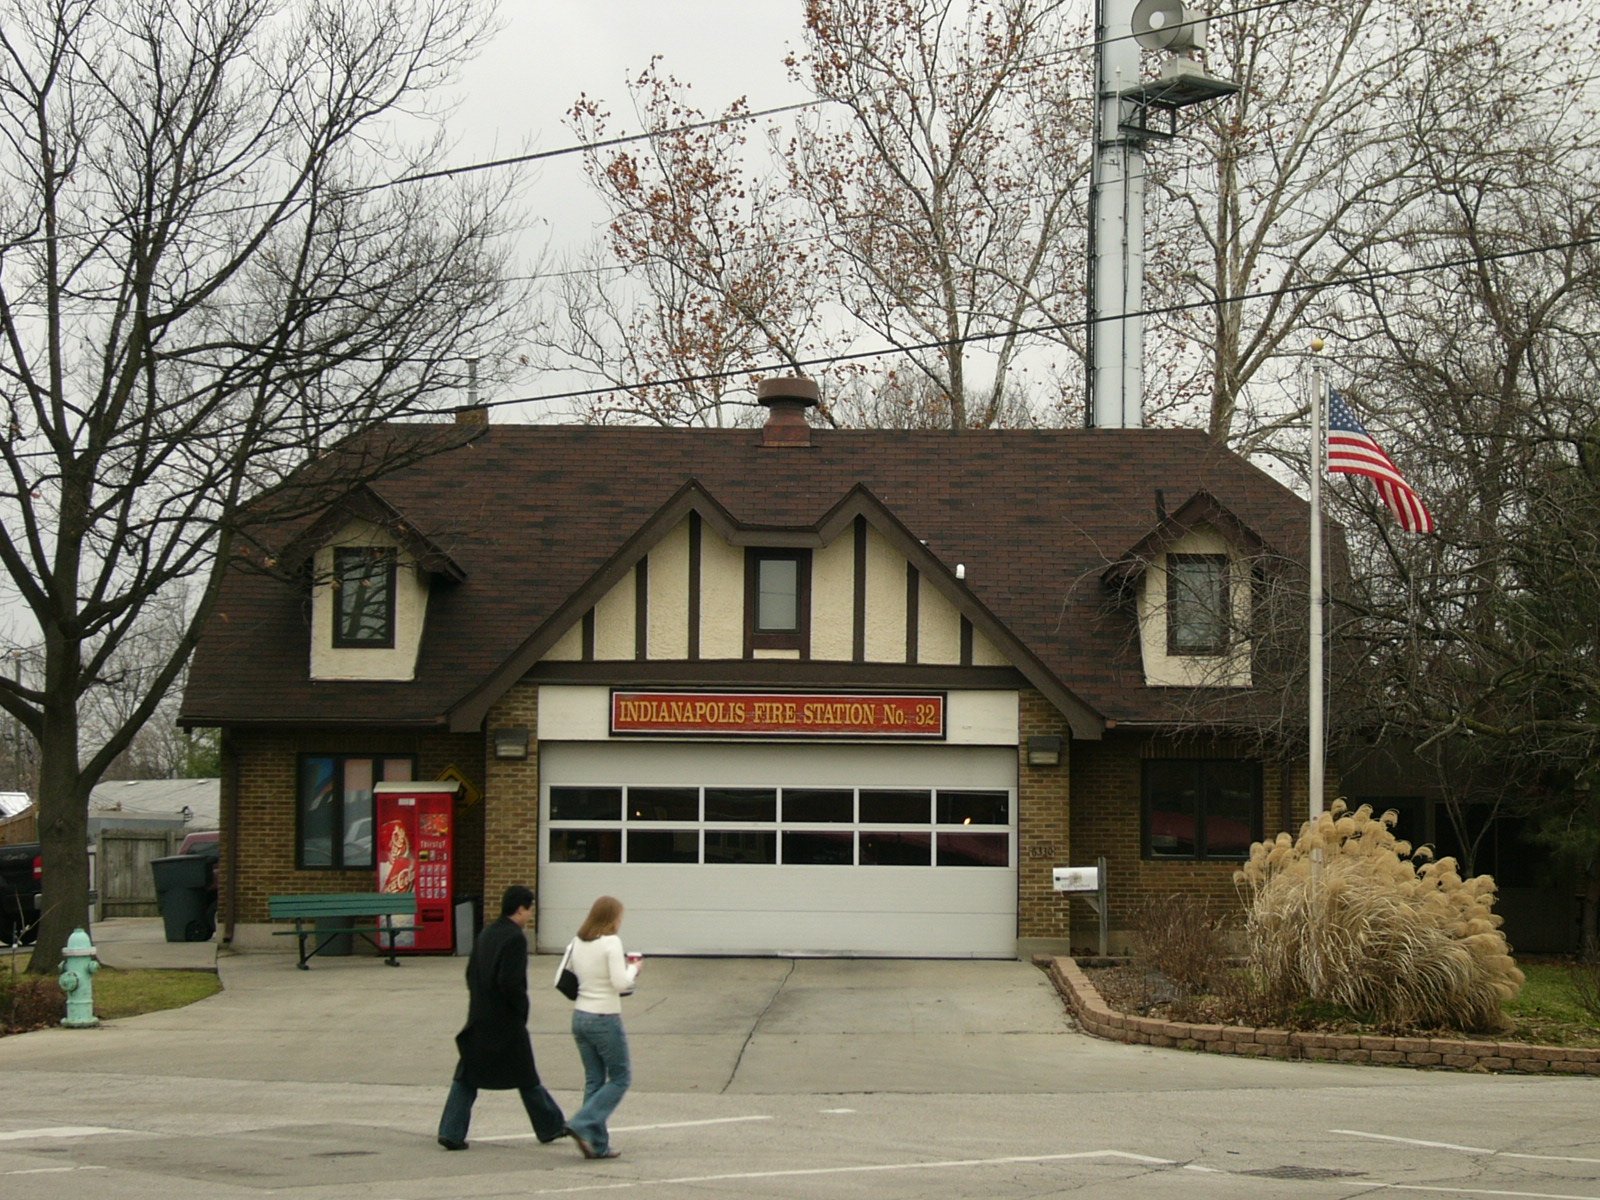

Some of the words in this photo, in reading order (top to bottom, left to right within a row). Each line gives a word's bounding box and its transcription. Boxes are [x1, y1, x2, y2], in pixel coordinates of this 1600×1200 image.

[619, 701, 746, 723] INDIANAPOLIS
[753, 702, 796, 724] FIRE
[803, 703, 876, 725] STATION
[882, 704, 908, 725] No.
[916, 704, 936, 726] 32
